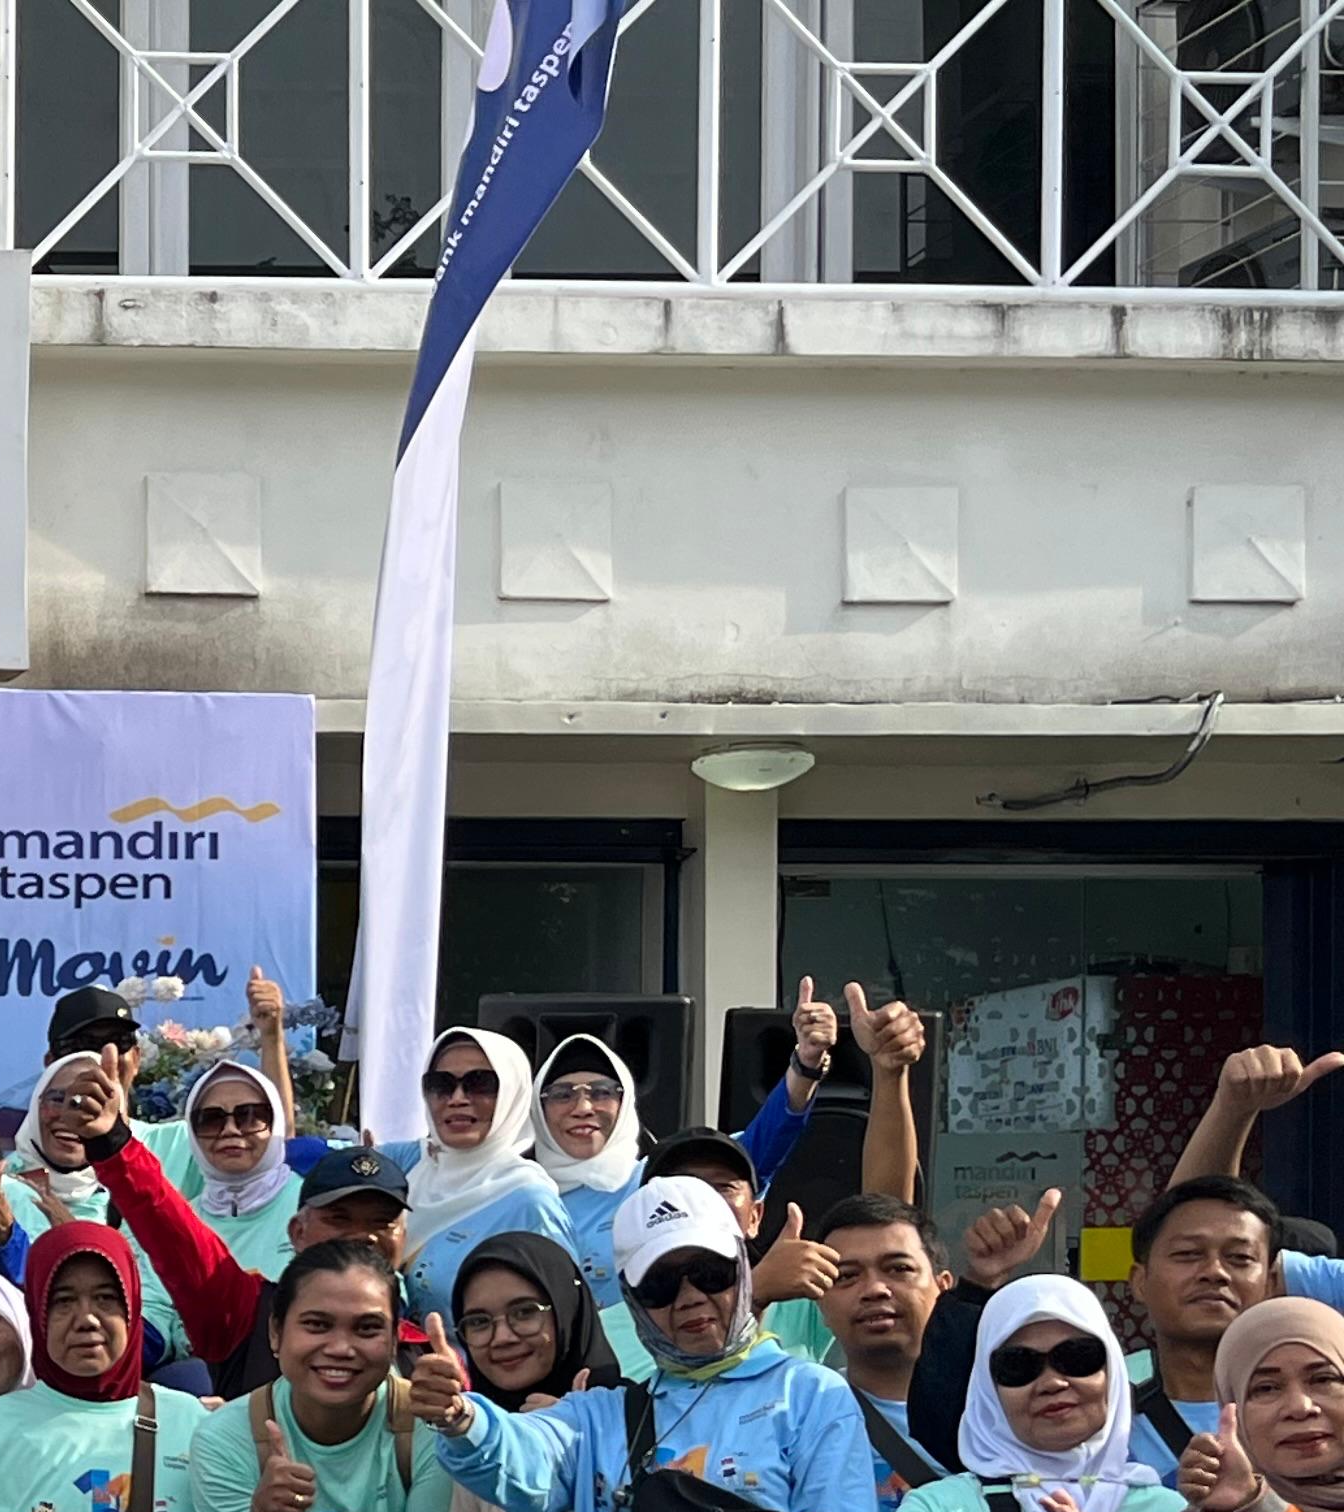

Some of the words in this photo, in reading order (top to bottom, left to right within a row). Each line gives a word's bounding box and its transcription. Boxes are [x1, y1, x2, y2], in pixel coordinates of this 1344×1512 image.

[432, 230, 463, 297] ank
[460, 114, 520, 226] mandiri
[953, 1161, 1036, 1181] mandiri
